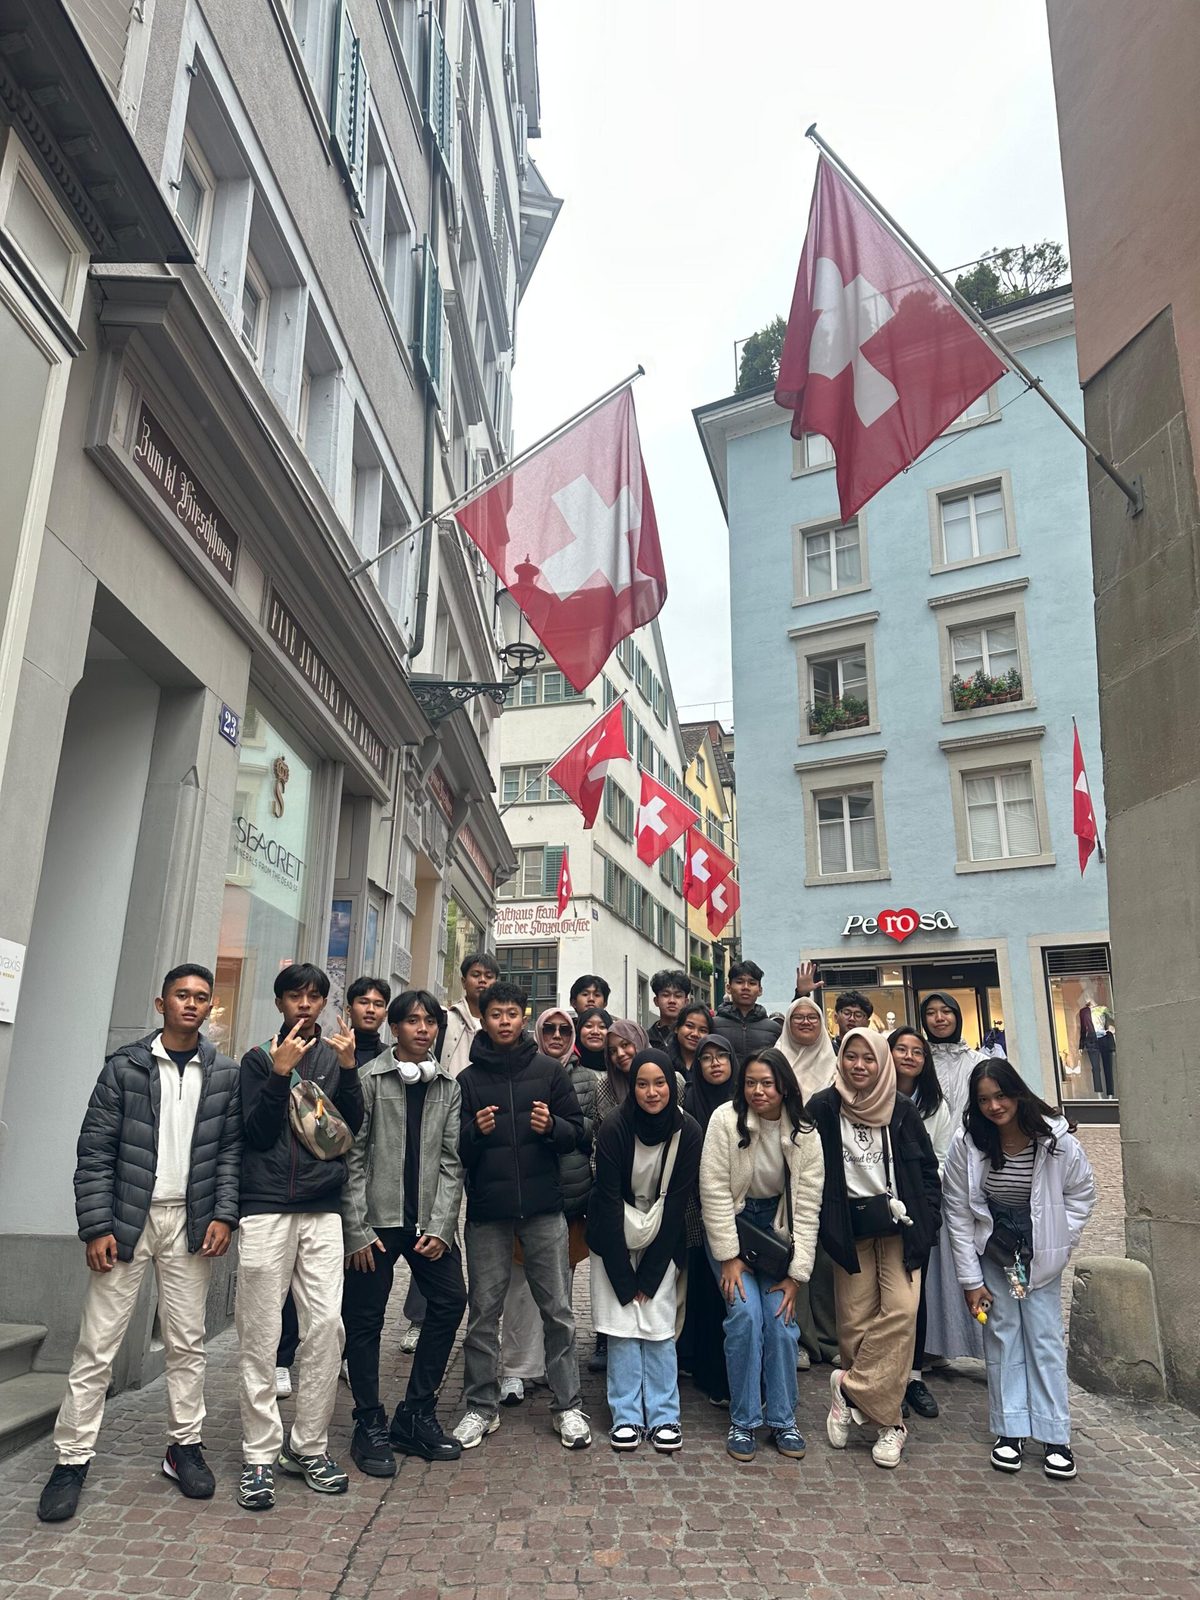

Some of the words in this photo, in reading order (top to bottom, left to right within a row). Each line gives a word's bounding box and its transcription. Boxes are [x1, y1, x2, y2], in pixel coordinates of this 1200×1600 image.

[176, 471, 232, 571] Hirschhorn
[271, 600, 297, 656] FINE
[300, 640, 340, 714] JEWELRY
[223, 710, 237, 738] 23
[236, 816, 304, 882] SEACRET
